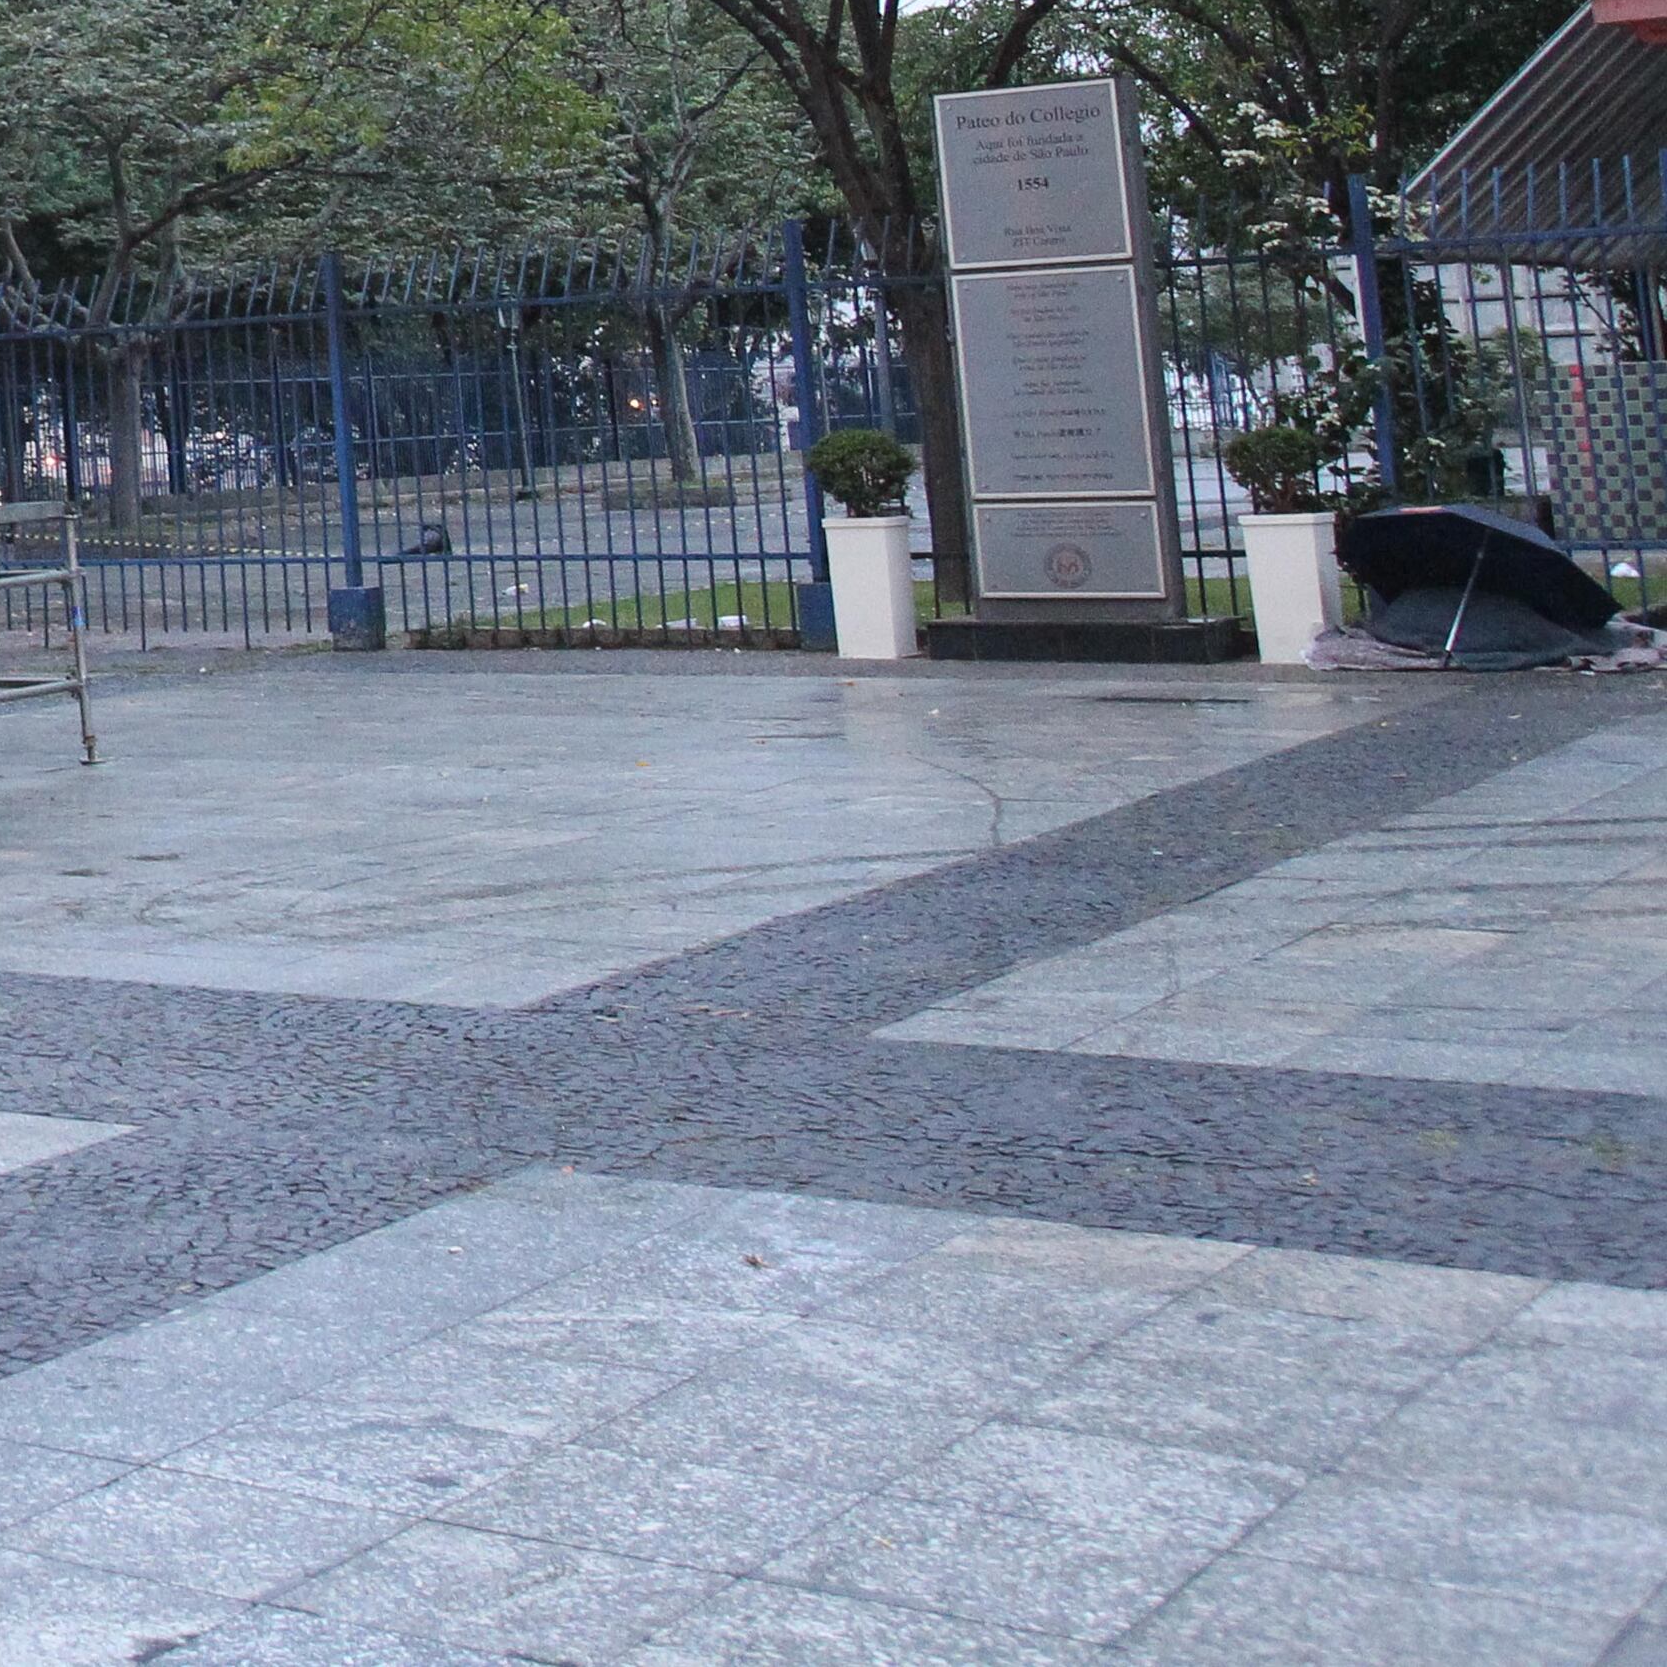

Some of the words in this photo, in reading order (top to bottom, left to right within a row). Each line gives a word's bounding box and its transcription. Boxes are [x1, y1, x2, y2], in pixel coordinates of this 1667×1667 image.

[956, 114, 1000, 130] Pateo
[1005, 111, 1025, 125] do
[1030, 105, 1101, 124] Collegio
[1007, 137, 1023, 149] foi
[972, 152, 1010, 165] cidade
[1013, 149, 1027, 162] de
[1030, 147, 1052, 160] São
[1055, 145, 1089, 158] Paulo
[1017, 177, 1049, 191] 1554
